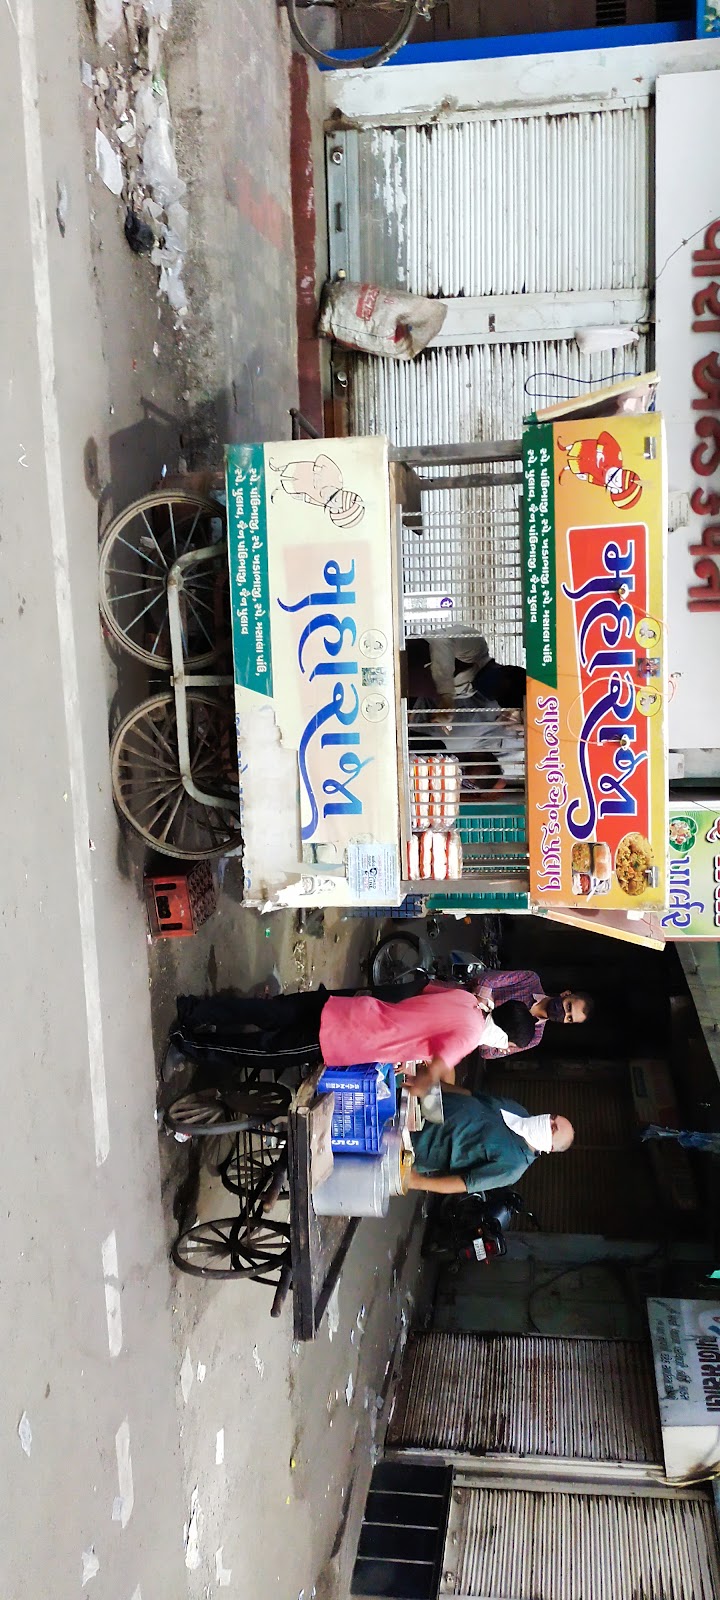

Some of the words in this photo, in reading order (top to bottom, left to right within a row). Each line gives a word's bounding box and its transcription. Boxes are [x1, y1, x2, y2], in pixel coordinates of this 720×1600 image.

[255, 622, 264, 652] મસાલા
[277, 559, 375, 840] મહારાજા
[542, 610, 551, 642] મસાલા
[562, 540, 647, 841] મહારાજા
